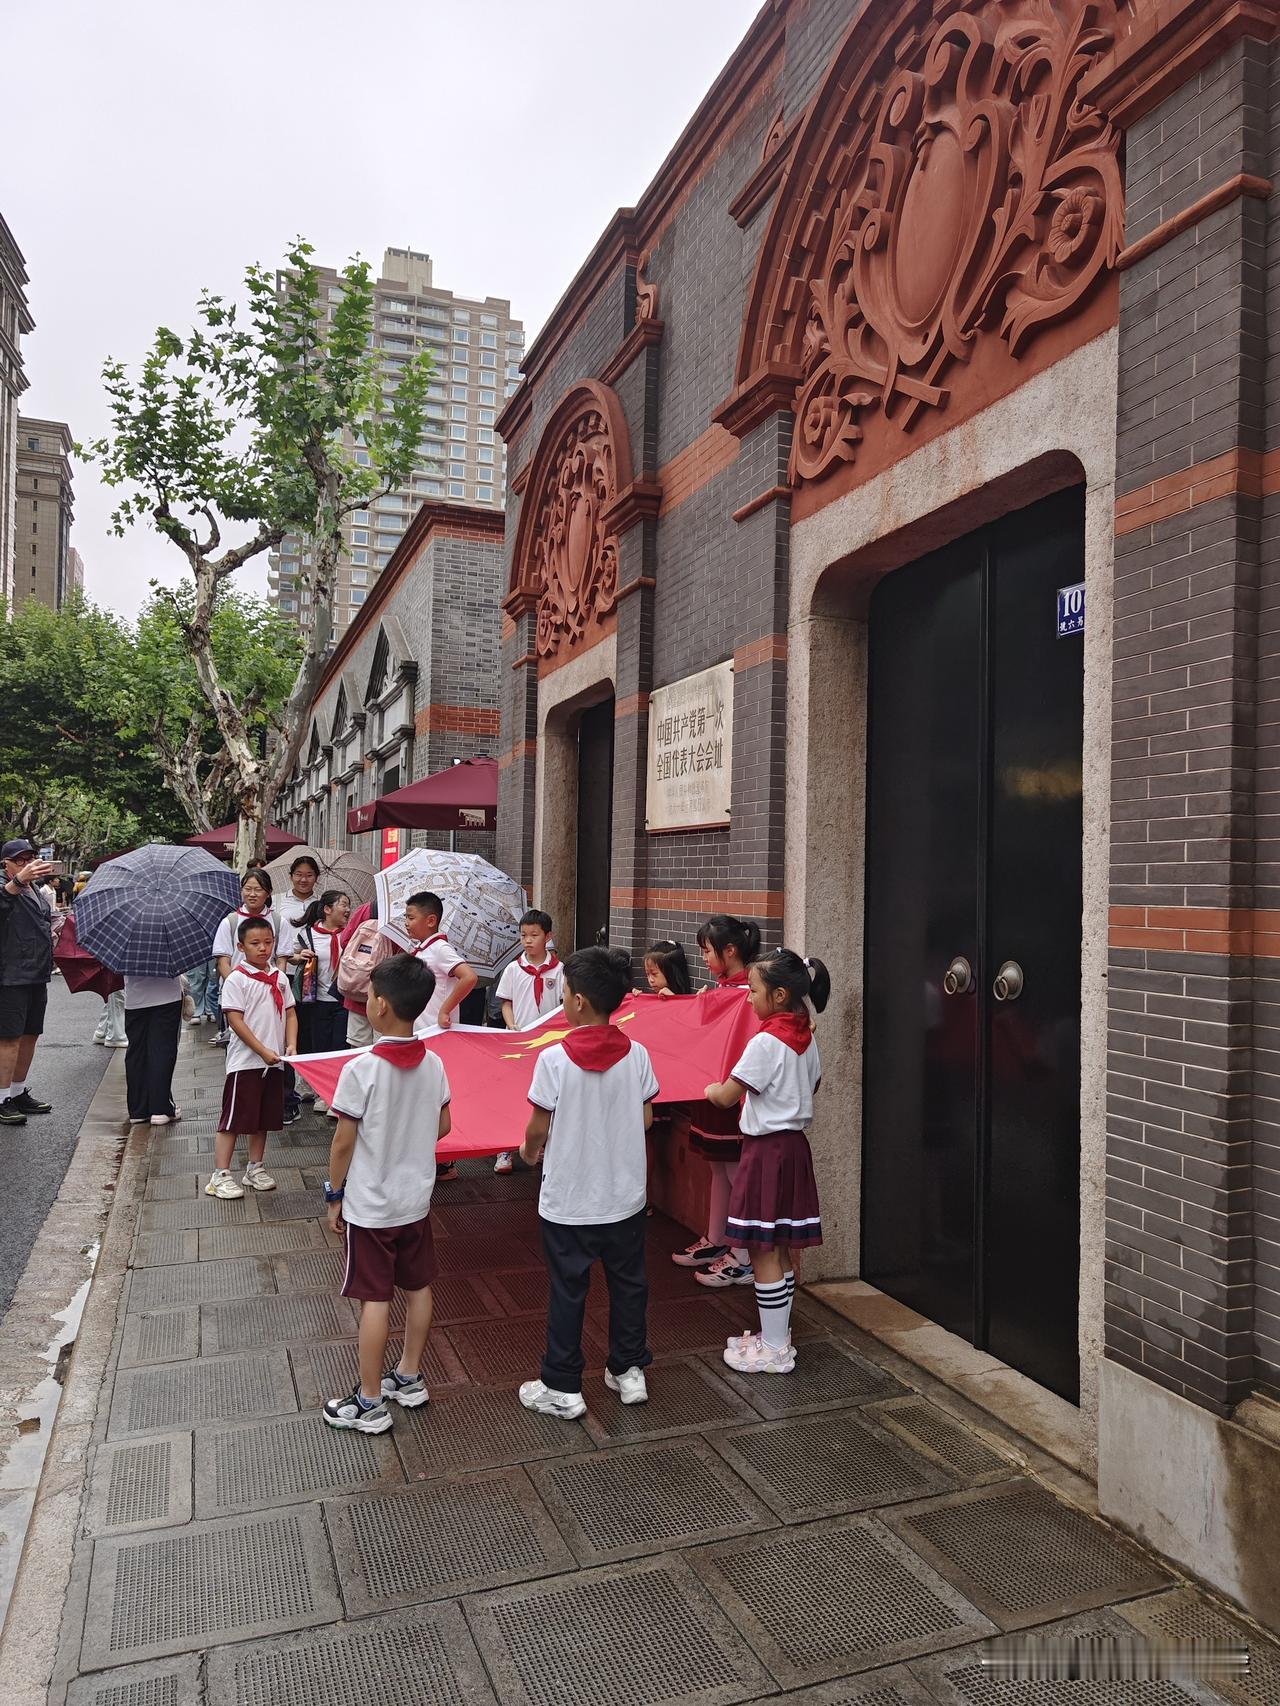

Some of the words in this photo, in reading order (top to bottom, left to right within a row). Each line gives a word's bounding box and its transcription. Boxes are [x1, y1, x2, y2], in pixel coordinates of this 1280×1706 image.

[656, 701, 724, 748] 中国共产党第一次
[656, 738, 723, 782] 全国代表大会会址
